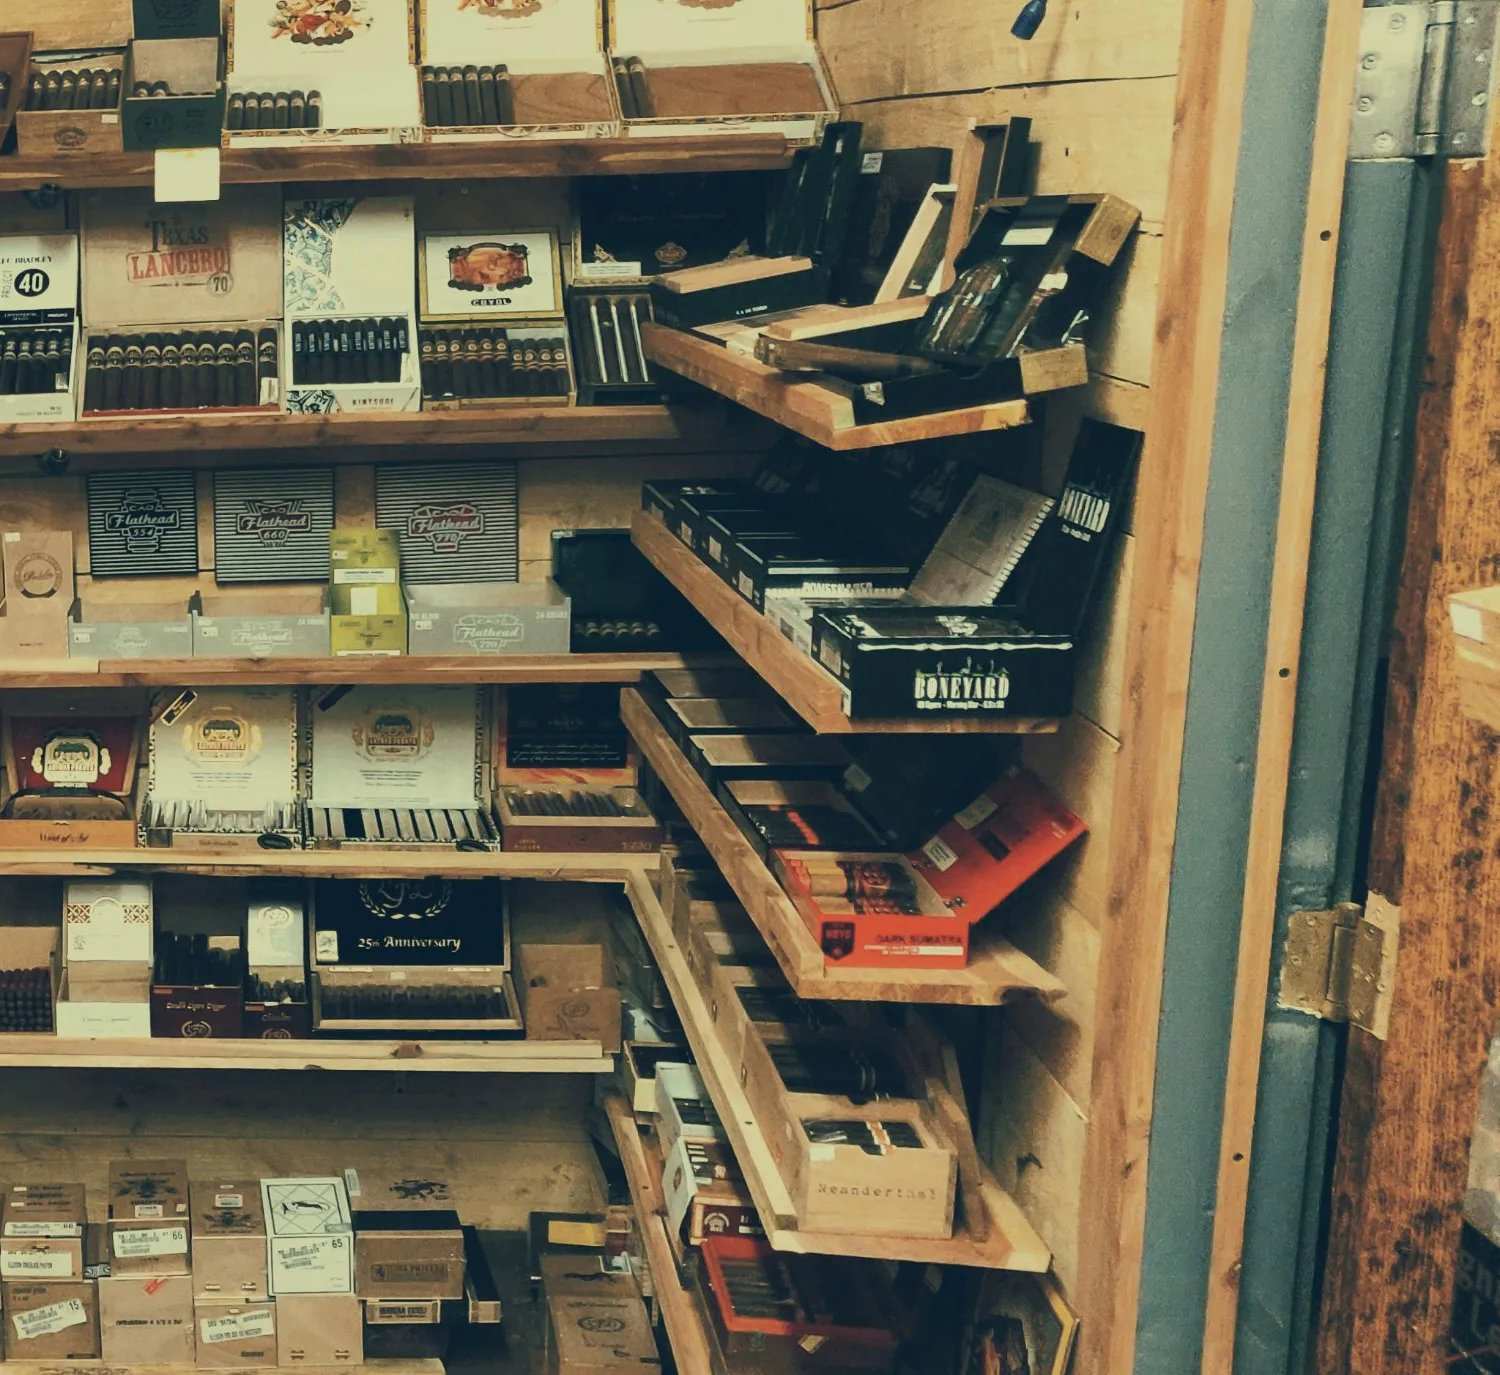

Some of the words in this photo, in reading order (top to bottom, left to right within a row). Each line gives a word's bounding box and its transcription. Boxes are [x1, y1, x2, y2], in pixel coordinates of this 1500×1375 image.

[130, 249, 230, 281] LANCERO
[18, 272, 45, 293] 40
[213, 276, 228, 292] 70
[108, 512, 176, 528] Flathead
[240, 514, 307, 530] Flathead
[412, 516, 480, 533] Flathead
[263, 530, 285, 540] 660
[459, 626, 520, 639] Flathead
[914, 676, 1010, 700] BONEYARD
[383, 936, 461, 953] Anniversary
[819, 1180, 937, 1201] Neanderthal
[332, 1239, 343, 1249] 65
[68, 1301, 80, 1311] 15
